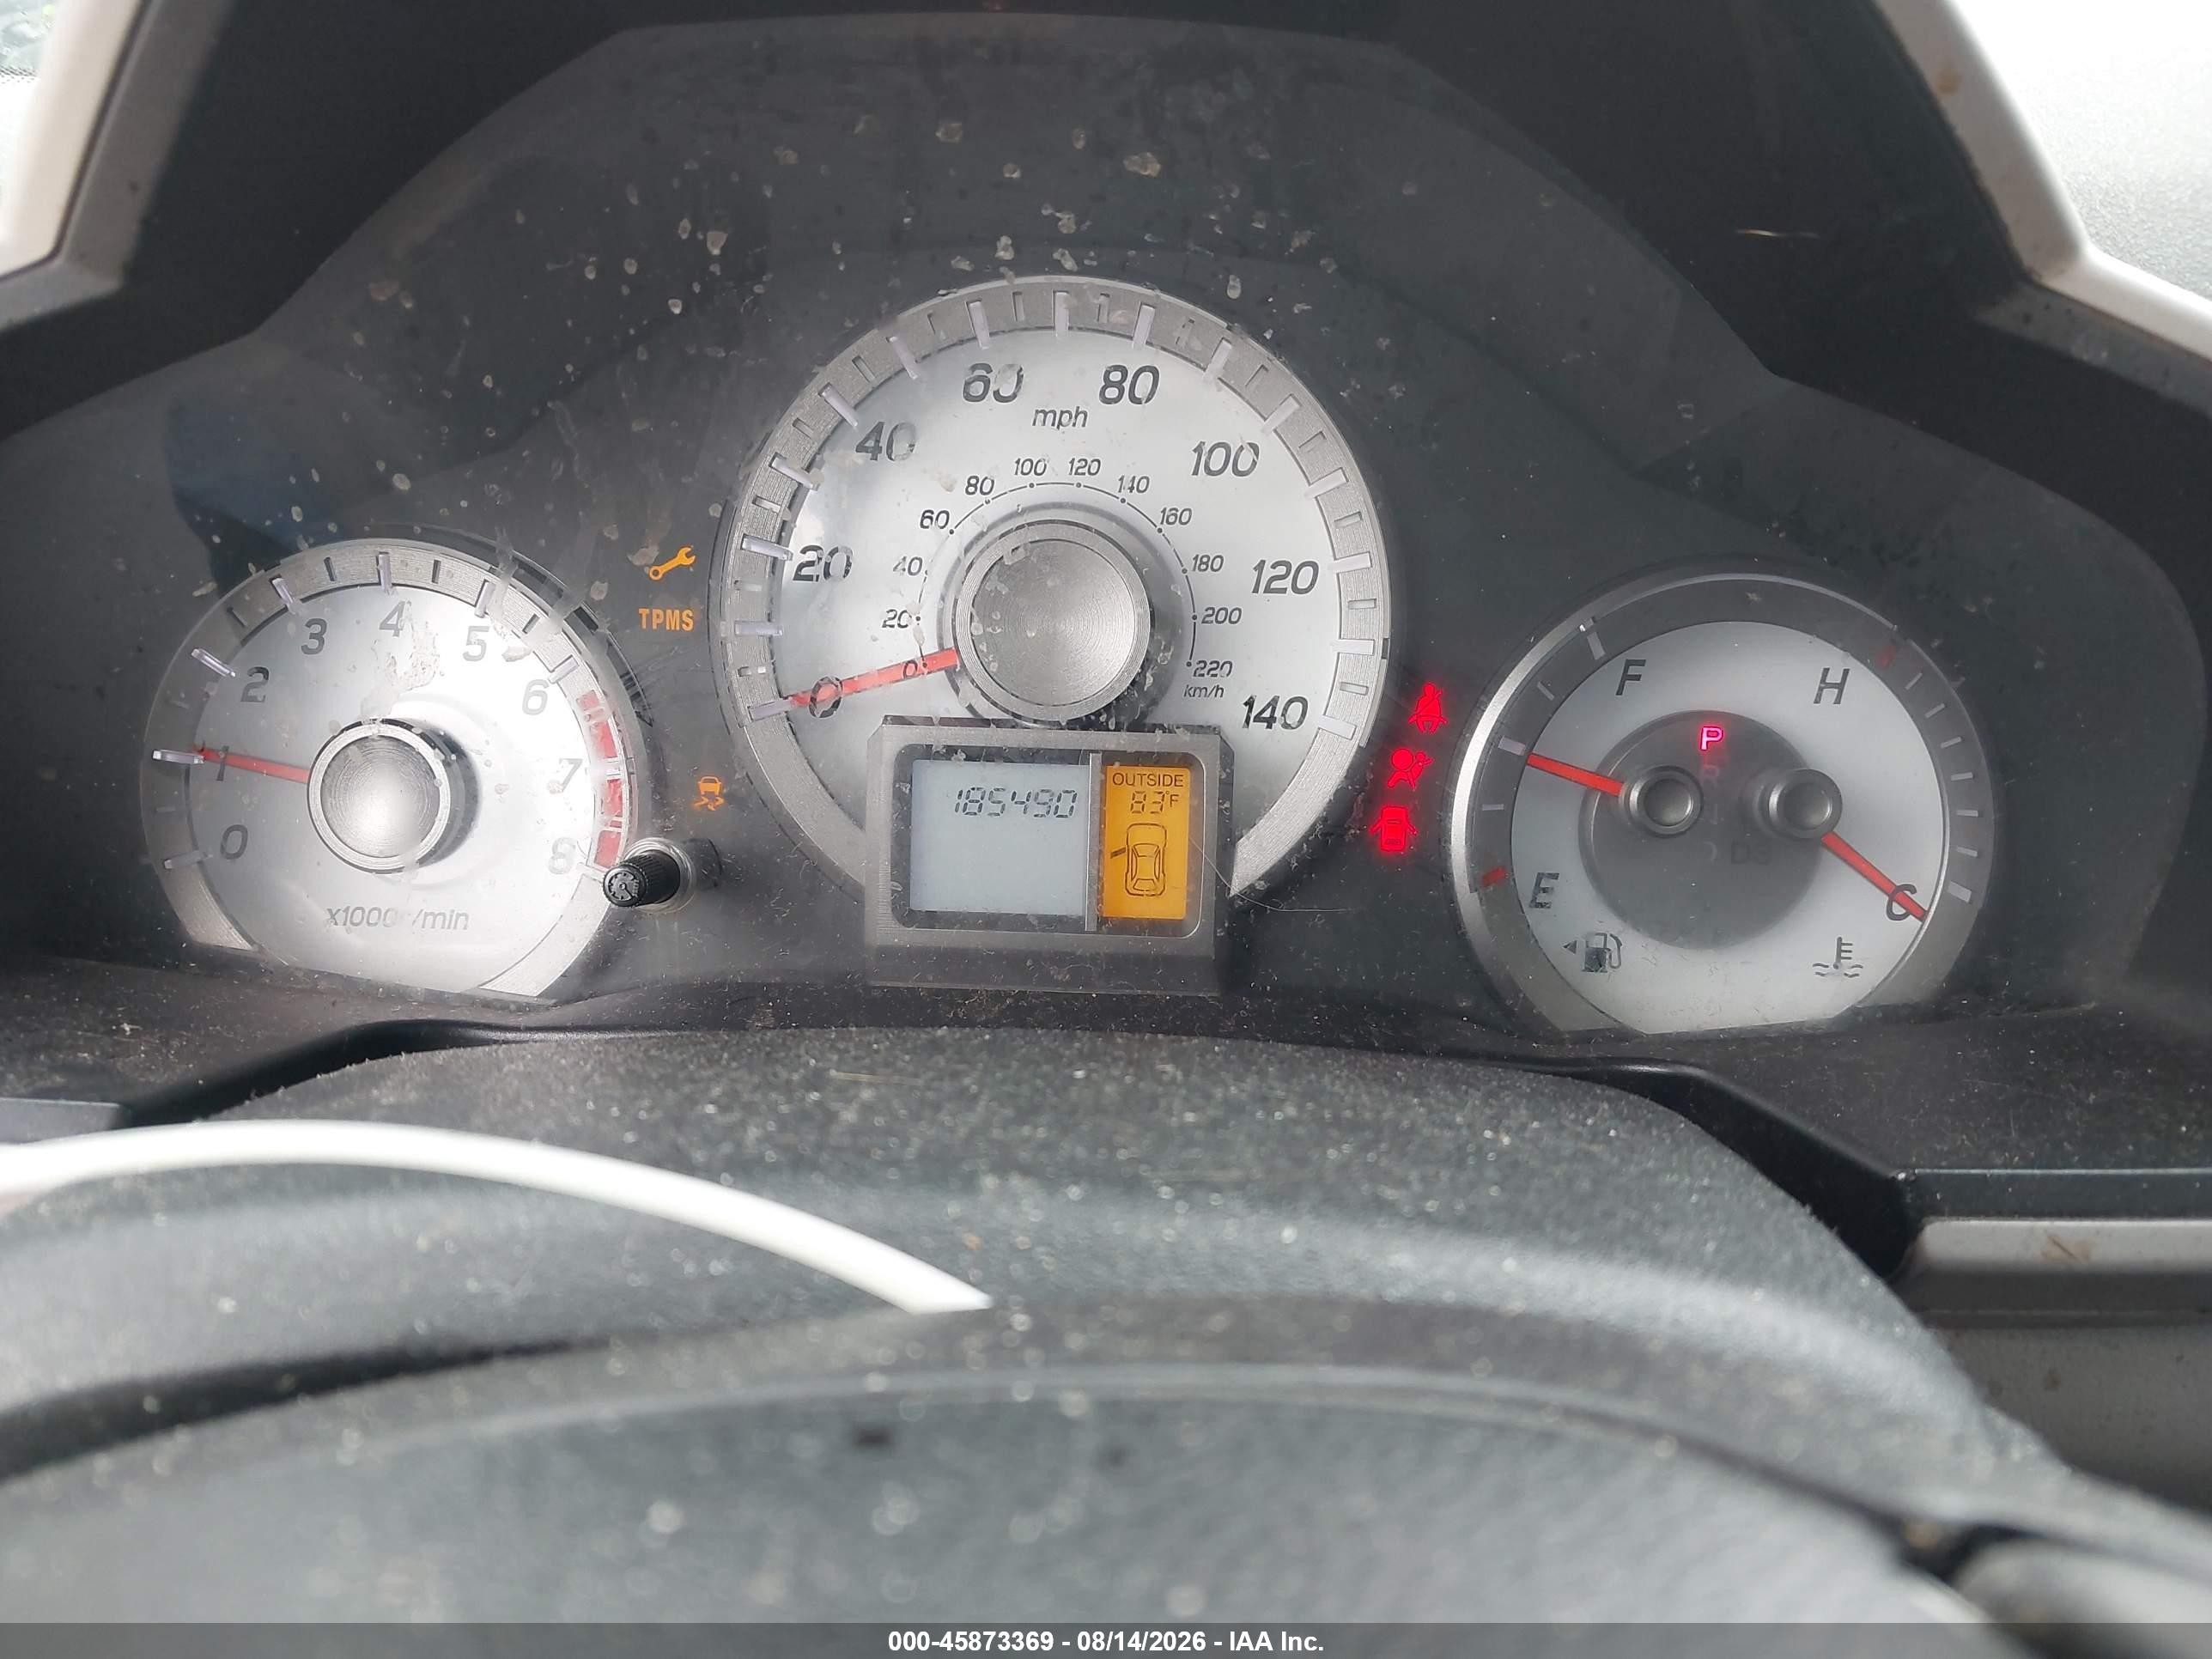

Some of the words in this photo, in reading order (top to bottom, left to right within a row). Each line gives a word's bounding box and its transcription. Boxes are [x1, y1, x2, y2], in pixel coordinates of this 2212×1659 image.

[963, 362, 1024, 404] 60
[1098, 365, 1160, 404] 80
[1032, 406, 1088, 429] mph
[855, 422, 915, 462] 40
[1013, 459, 1047, 477] 100
[1067, 459, 1101, 477] 120
[1192, 441, 1260, 478] 100
[964, 476, 994, 496] 80
[1116, 476, 1149, 495] 140
[919, 509, 950, 531] 60
[1159, 507, 1192, 526] 160
[793, 544, 853, 582] 20
[892, 555, 924, 576] 40
[1192, 555, 1224, 574] 180
[1251, 559, 1319, 595] 120
[379, 601, 405, 636] 4
[639, 608, 694, 632] TPMS
[882, 610, 911, 629] 20
[1201, 607, 1242, 626] 200
[301, 618, 327, 654] 3
[463, 625, 489, 661] 5
[240, 667, 270, 702] 2
[902, 659, 917, 678] 0
[1194, 660, 1233, 679] 220
[1616, 659, 1646, 696] F
[522, 679, 548, 714] 6
[809, 677, 842, 718] 0
[1183, 683, 1224, 700] km/h
[1813, 668, 1850, 704] H
[1242, 695, 1308, 731] 140
[1700, 726, 1723, 750] P
[216, 745, 228, 781] 1
[558, 758, 582, 791] 7
[1112, 773, 1183, 787] OUTSIDE
[955, 787, 1078, 818] 185490
[220, 825, 248, 859] 0
[548, 838, 575, 873] 8
[1529, 872, 1559, 908] E
[1886, 884, 1917, 921] C
